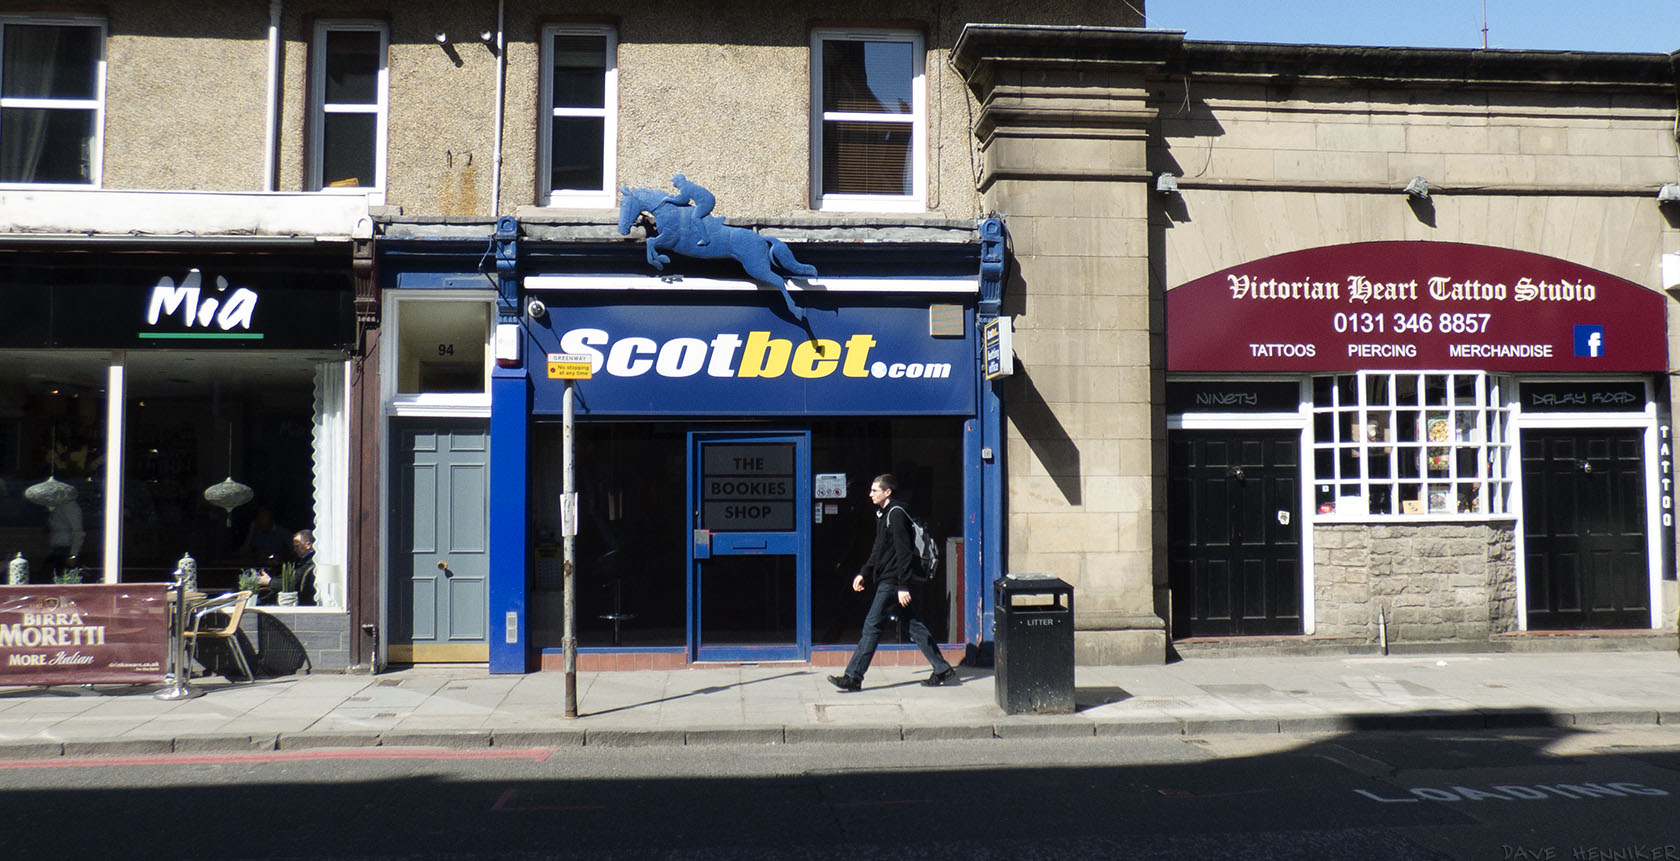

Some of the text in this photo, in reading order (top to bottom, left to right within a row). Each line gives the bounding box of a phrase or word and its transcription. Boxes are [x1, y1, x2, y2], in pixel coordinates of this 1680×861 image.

[1227, 274, 1596, 304] Victorian Heart Tattoo Studio
[148, 268, 258, 331] Mia
[1333, 312, 1491, 334] 0131 346 8857
[438, 343, 454, 356] 94
[1249, 344, 1553, 358] TATTOOS PIERCING MERCHANDISE
[1532, 391, 1637, 406] DALRY ROAD
[734, 457, 764, 471] THE
[1660, 425, 1672, 527] TATTOO
[711, 482, 786, 496] BOOKIES
[724, 505, 772, 520] SHOP
[23, 612, 84, 626] BIRRA
[0, 623, 105, 647] MORETTI
[9, 651, 94, 666] MORE Italian
[1353, 782, 1670, 802] LOADING
